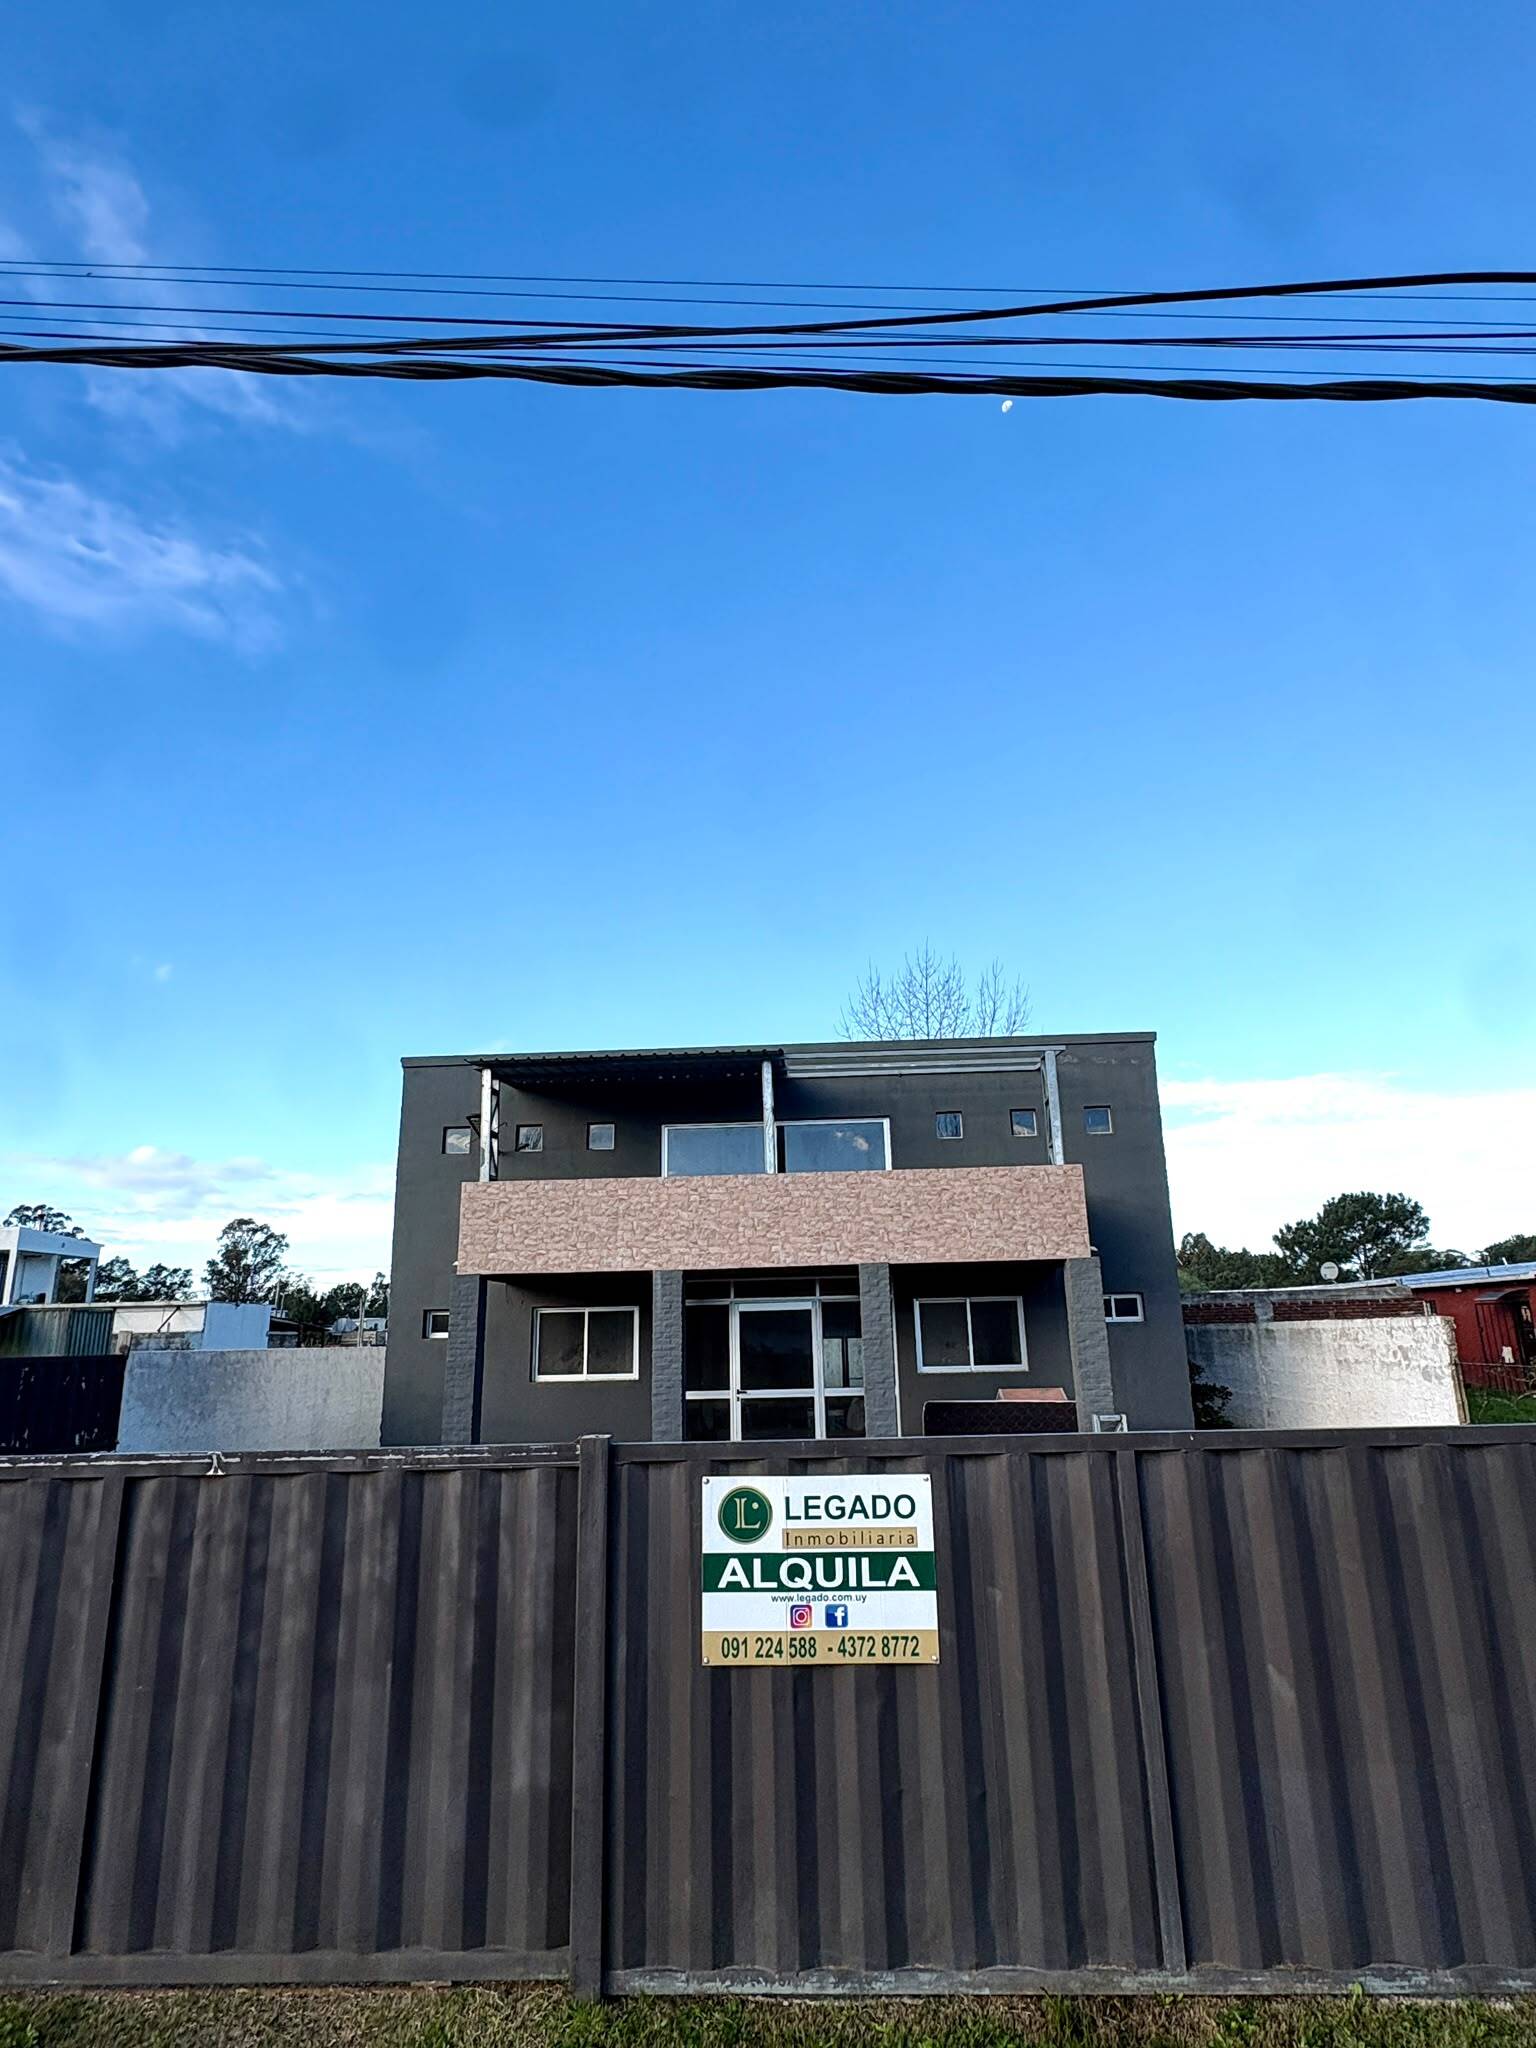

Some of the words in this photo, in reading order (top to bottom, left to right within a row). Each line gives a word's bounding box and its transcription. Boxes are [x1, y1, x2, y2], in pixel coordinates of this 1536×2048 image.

[785, 1494, 916, 1520] LEGADO
[785, 1530, 915, 1546] Inmobiliaria
[717, 1556, 921, 1590] ALQUILA
[771, 1593, 867, 1603] www.legado.com.uy
[721, 1636, 748, 1658] 091
[755, 1636, 784, 1658] 224
[788, 1636, 817, 1658] 588
[881, 1635, 920, 1657] 8772
